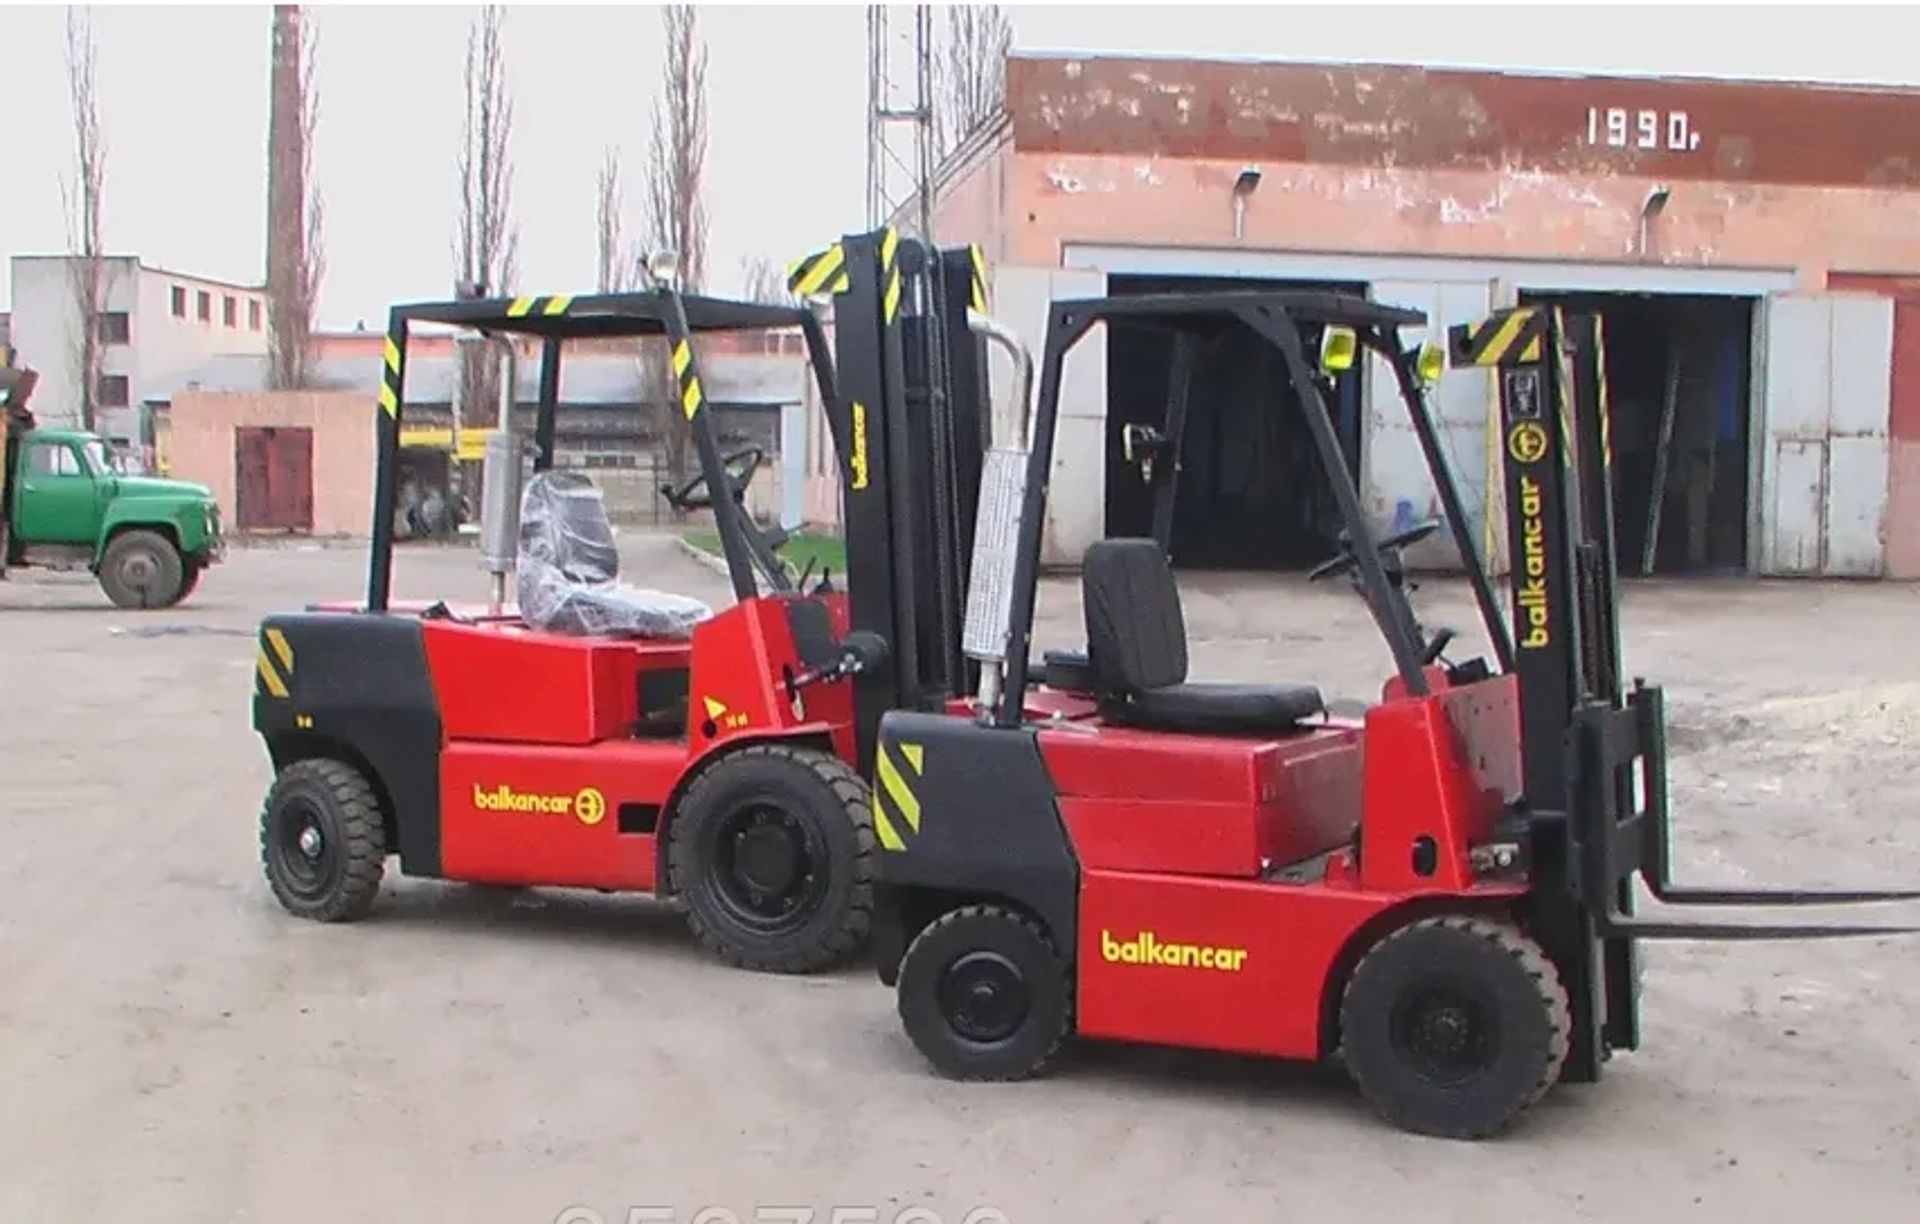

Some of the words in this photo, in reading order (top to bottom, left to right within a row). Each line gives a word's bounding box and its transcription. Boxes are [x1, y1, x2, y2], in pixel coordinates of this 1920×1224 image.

[1518, 475, 1549, 649] balkancar
[473, 782, 572, 814] balkancar
[1102, 929, 1248, 971] balkancar
